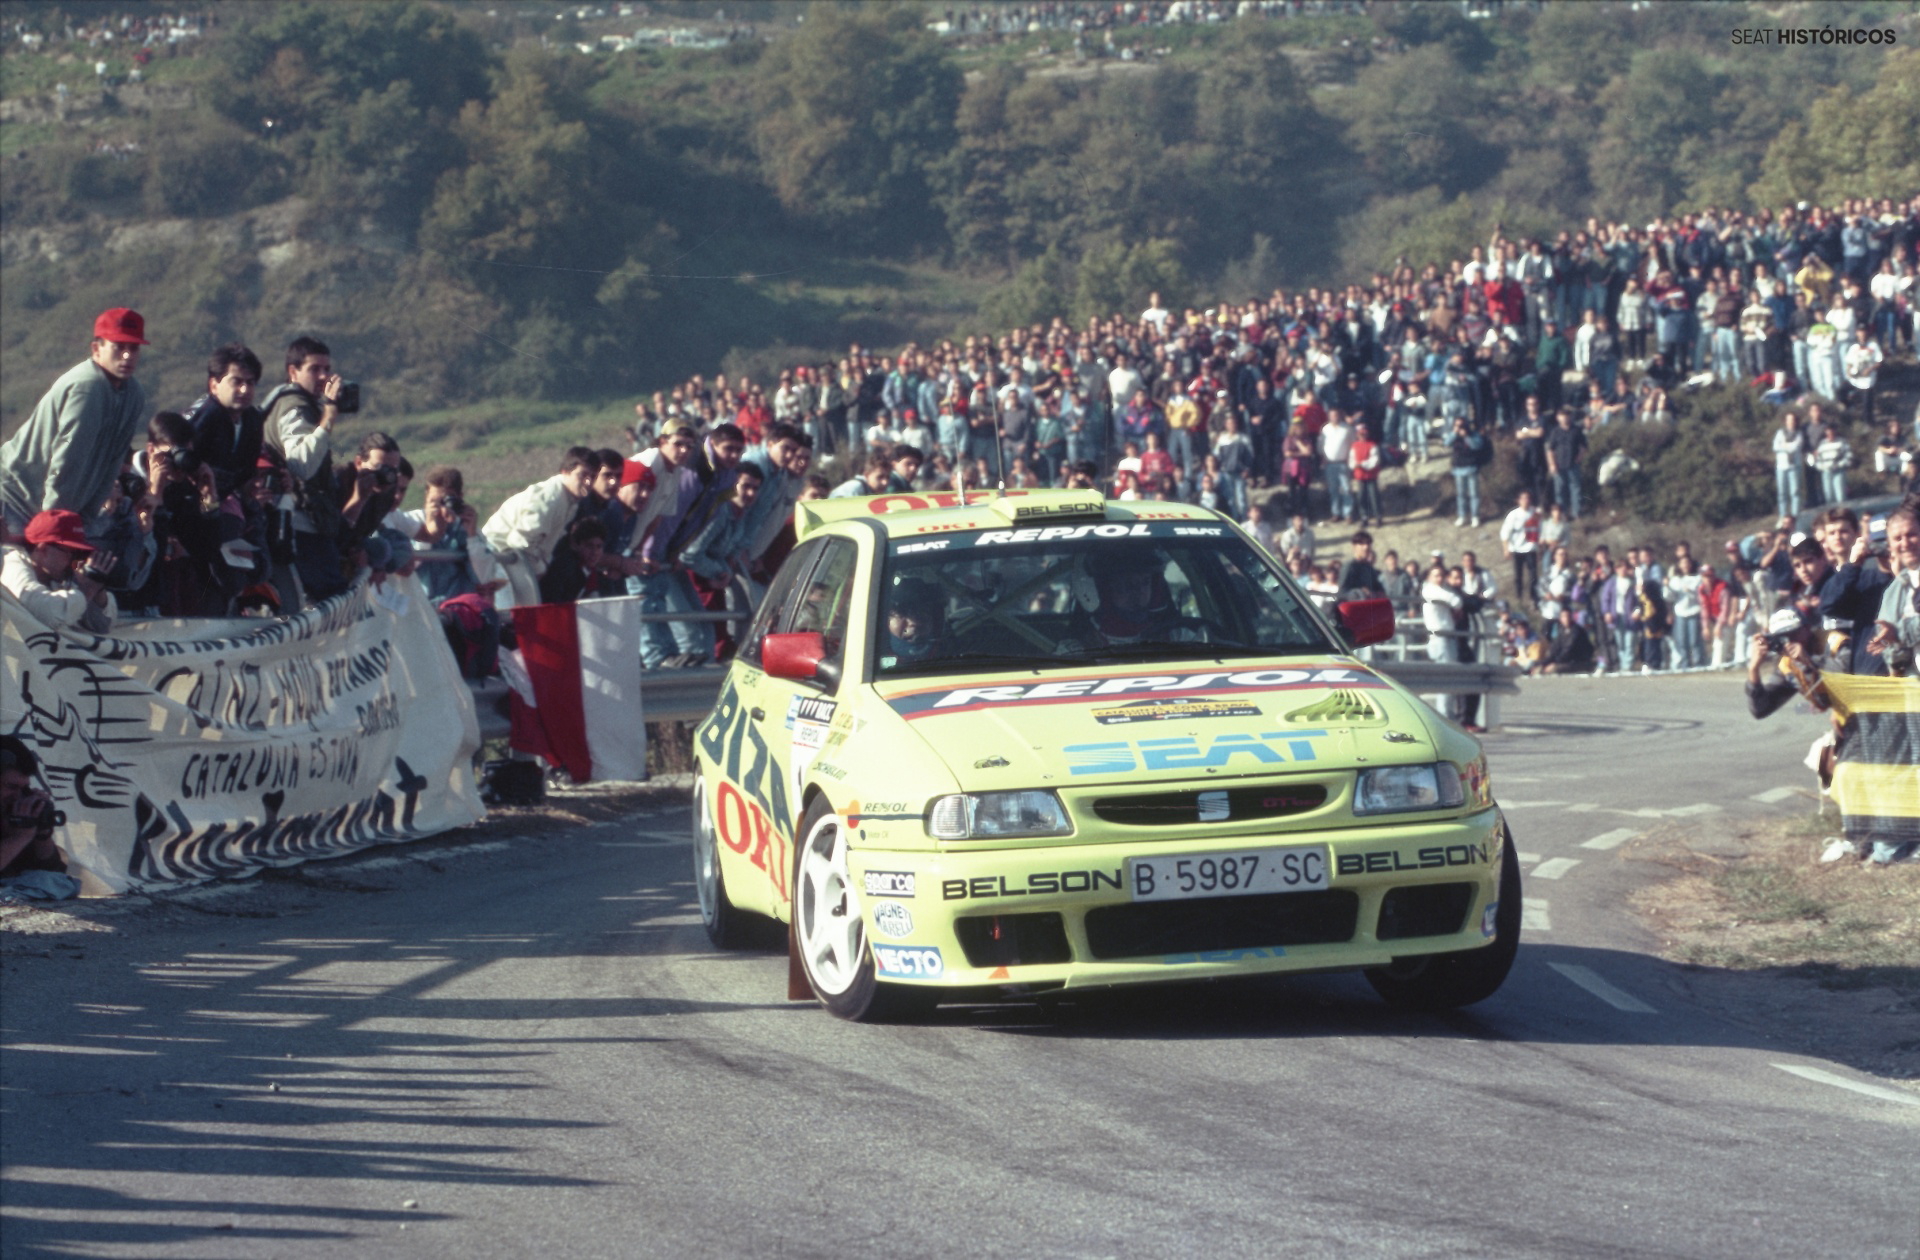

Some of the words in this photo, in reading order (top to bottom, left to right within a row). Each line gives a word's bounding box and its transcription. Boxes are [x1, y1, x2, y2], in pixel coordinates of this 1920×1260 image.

[1016, 502, 1105, 517] BELSON
[917, 522, 977, 533] OKI
[974, 524, 1153, 546] REPSOL
[1173, 527, 1223, 537] SEAT
[896, 540, 950, 555] SEAT
[933, 669, 1360, 708] REPSOL
[1062, 729, 1329, 776] SEAT
[1337, 843, 1488, 876] BELSON
[864, 872, 915, 896] sparco
[942, 868, 1123, 901] BELSON
